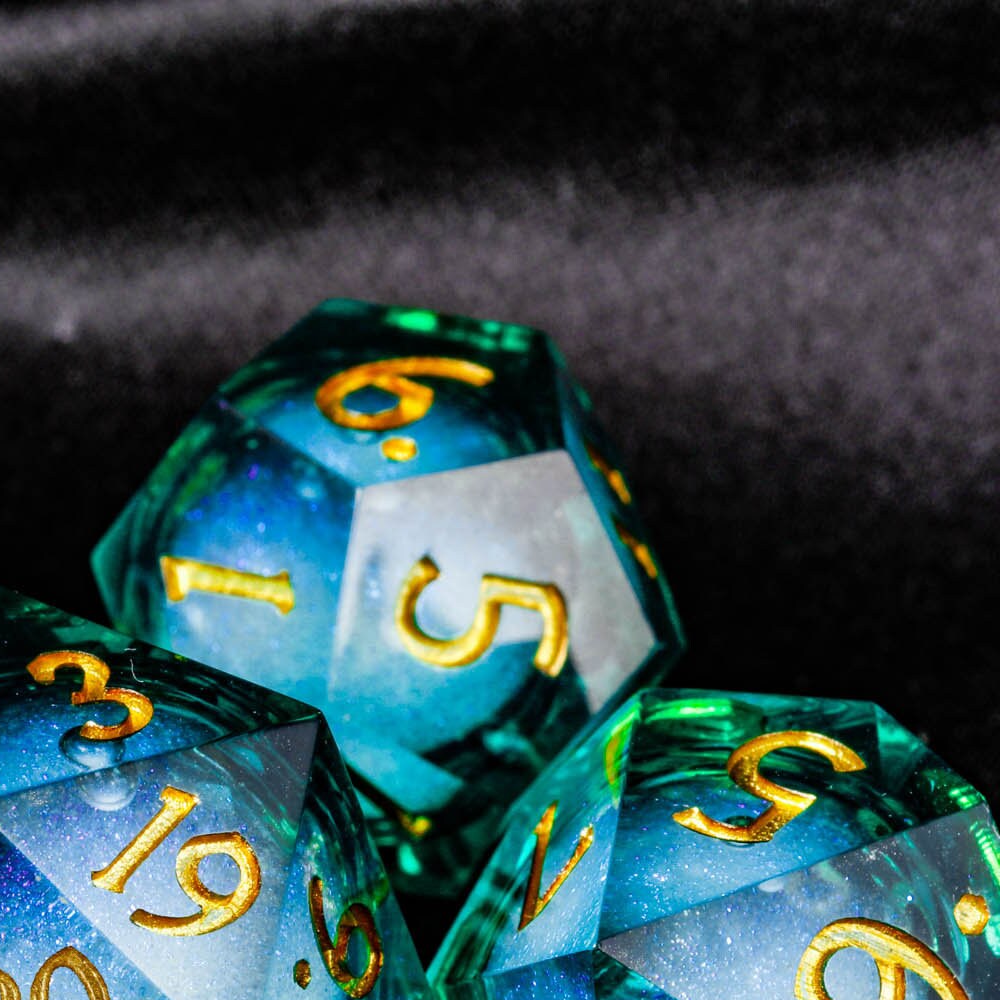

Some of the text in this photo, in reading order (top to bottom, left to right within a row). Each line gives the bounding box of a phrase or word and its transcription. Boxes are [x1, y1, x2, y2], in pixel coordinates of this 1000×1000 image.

[160, 555, 295, 616] 1
[395, 553, 568, 678] 5
[26, 650, 154, 740] 3
[672, 729, 868, 844] 5
[90, 785, 262, 937] 19
